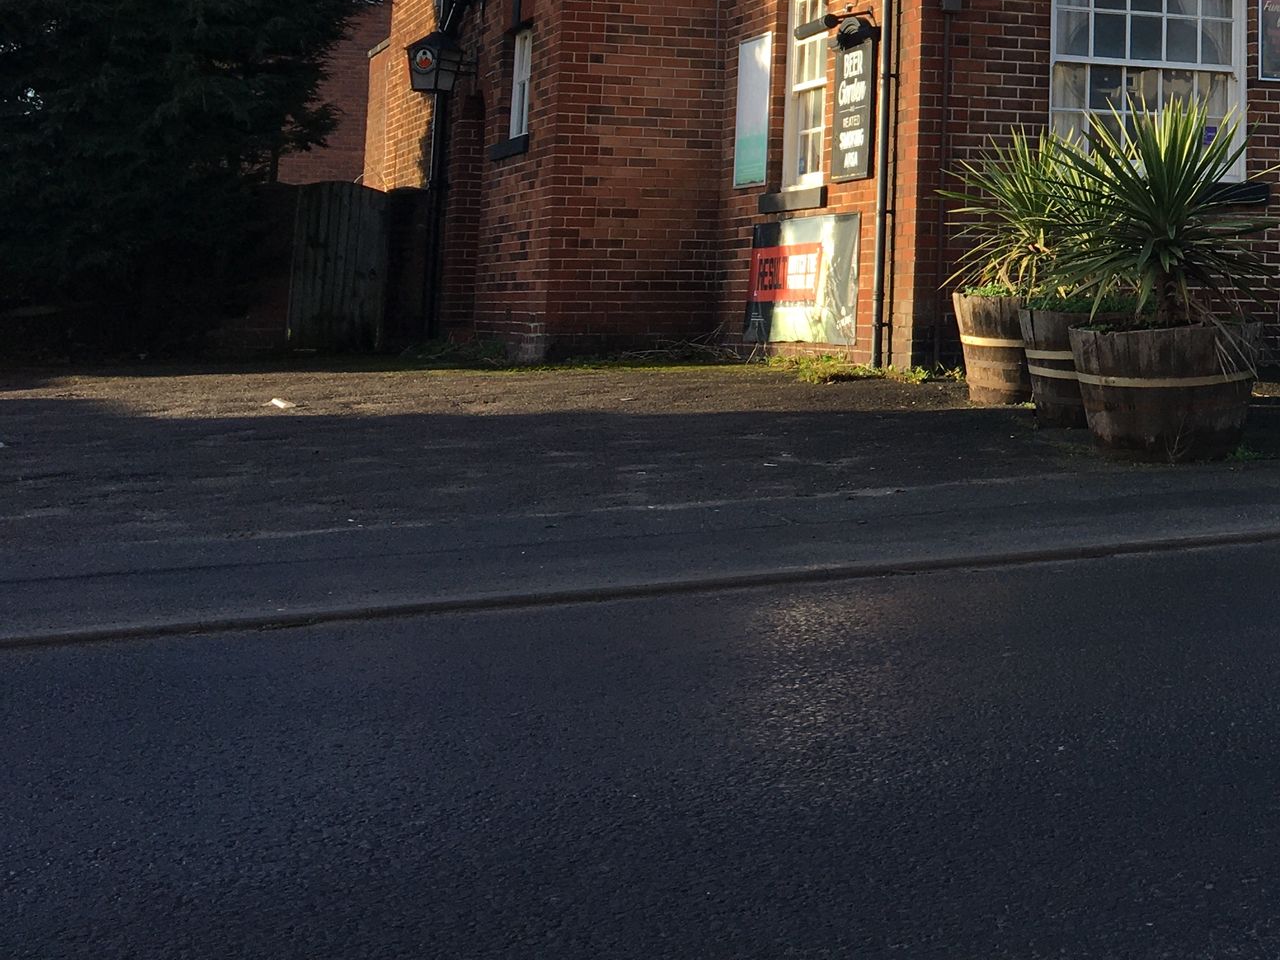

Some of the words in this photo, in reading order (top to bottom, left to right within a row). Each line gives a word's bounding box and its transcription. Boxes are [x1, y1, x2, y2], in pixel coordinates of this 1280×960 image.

[843, 50, 863, 79] BEER
[838, 78, 867, 107] Garden
[842, 114, 861, 129] HEATED
